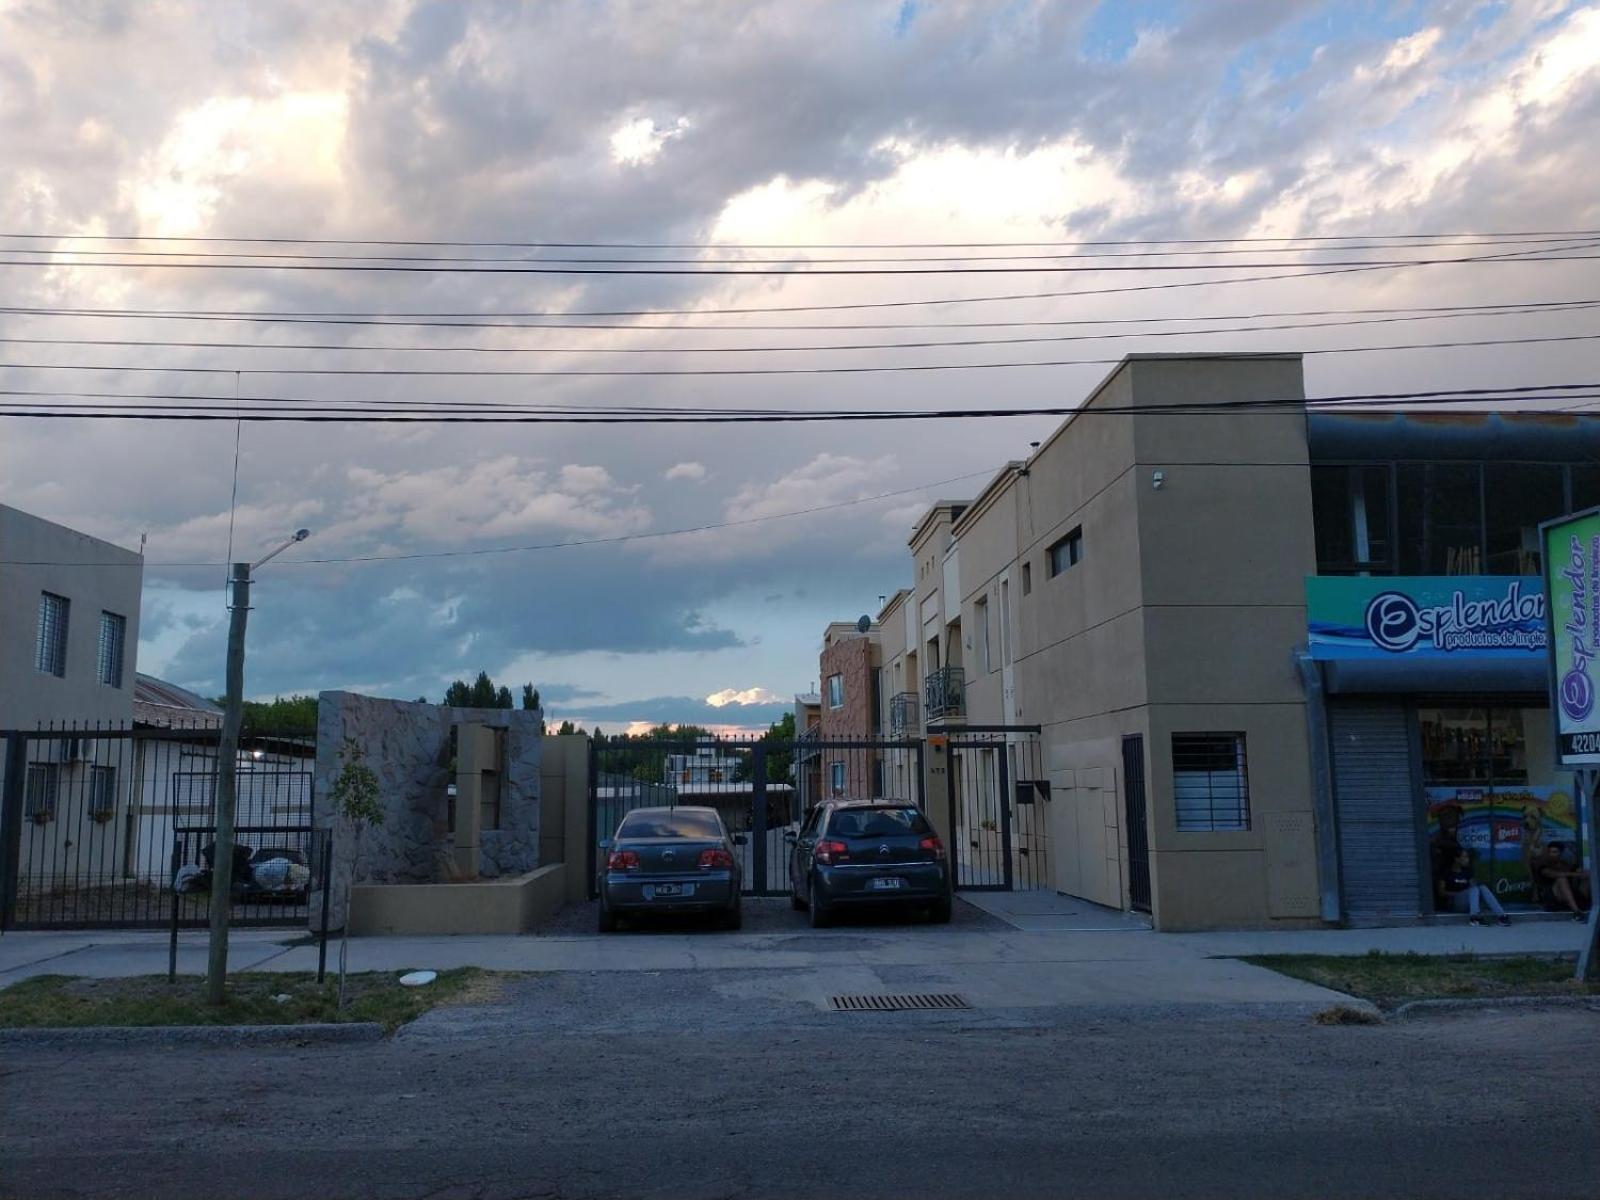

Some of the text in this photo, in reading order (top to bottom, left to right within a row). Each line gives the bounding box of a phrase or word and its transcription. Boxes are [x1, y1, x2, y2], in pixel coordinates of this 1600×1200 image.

[1445, 630, 1547, 650] productos de limpie
